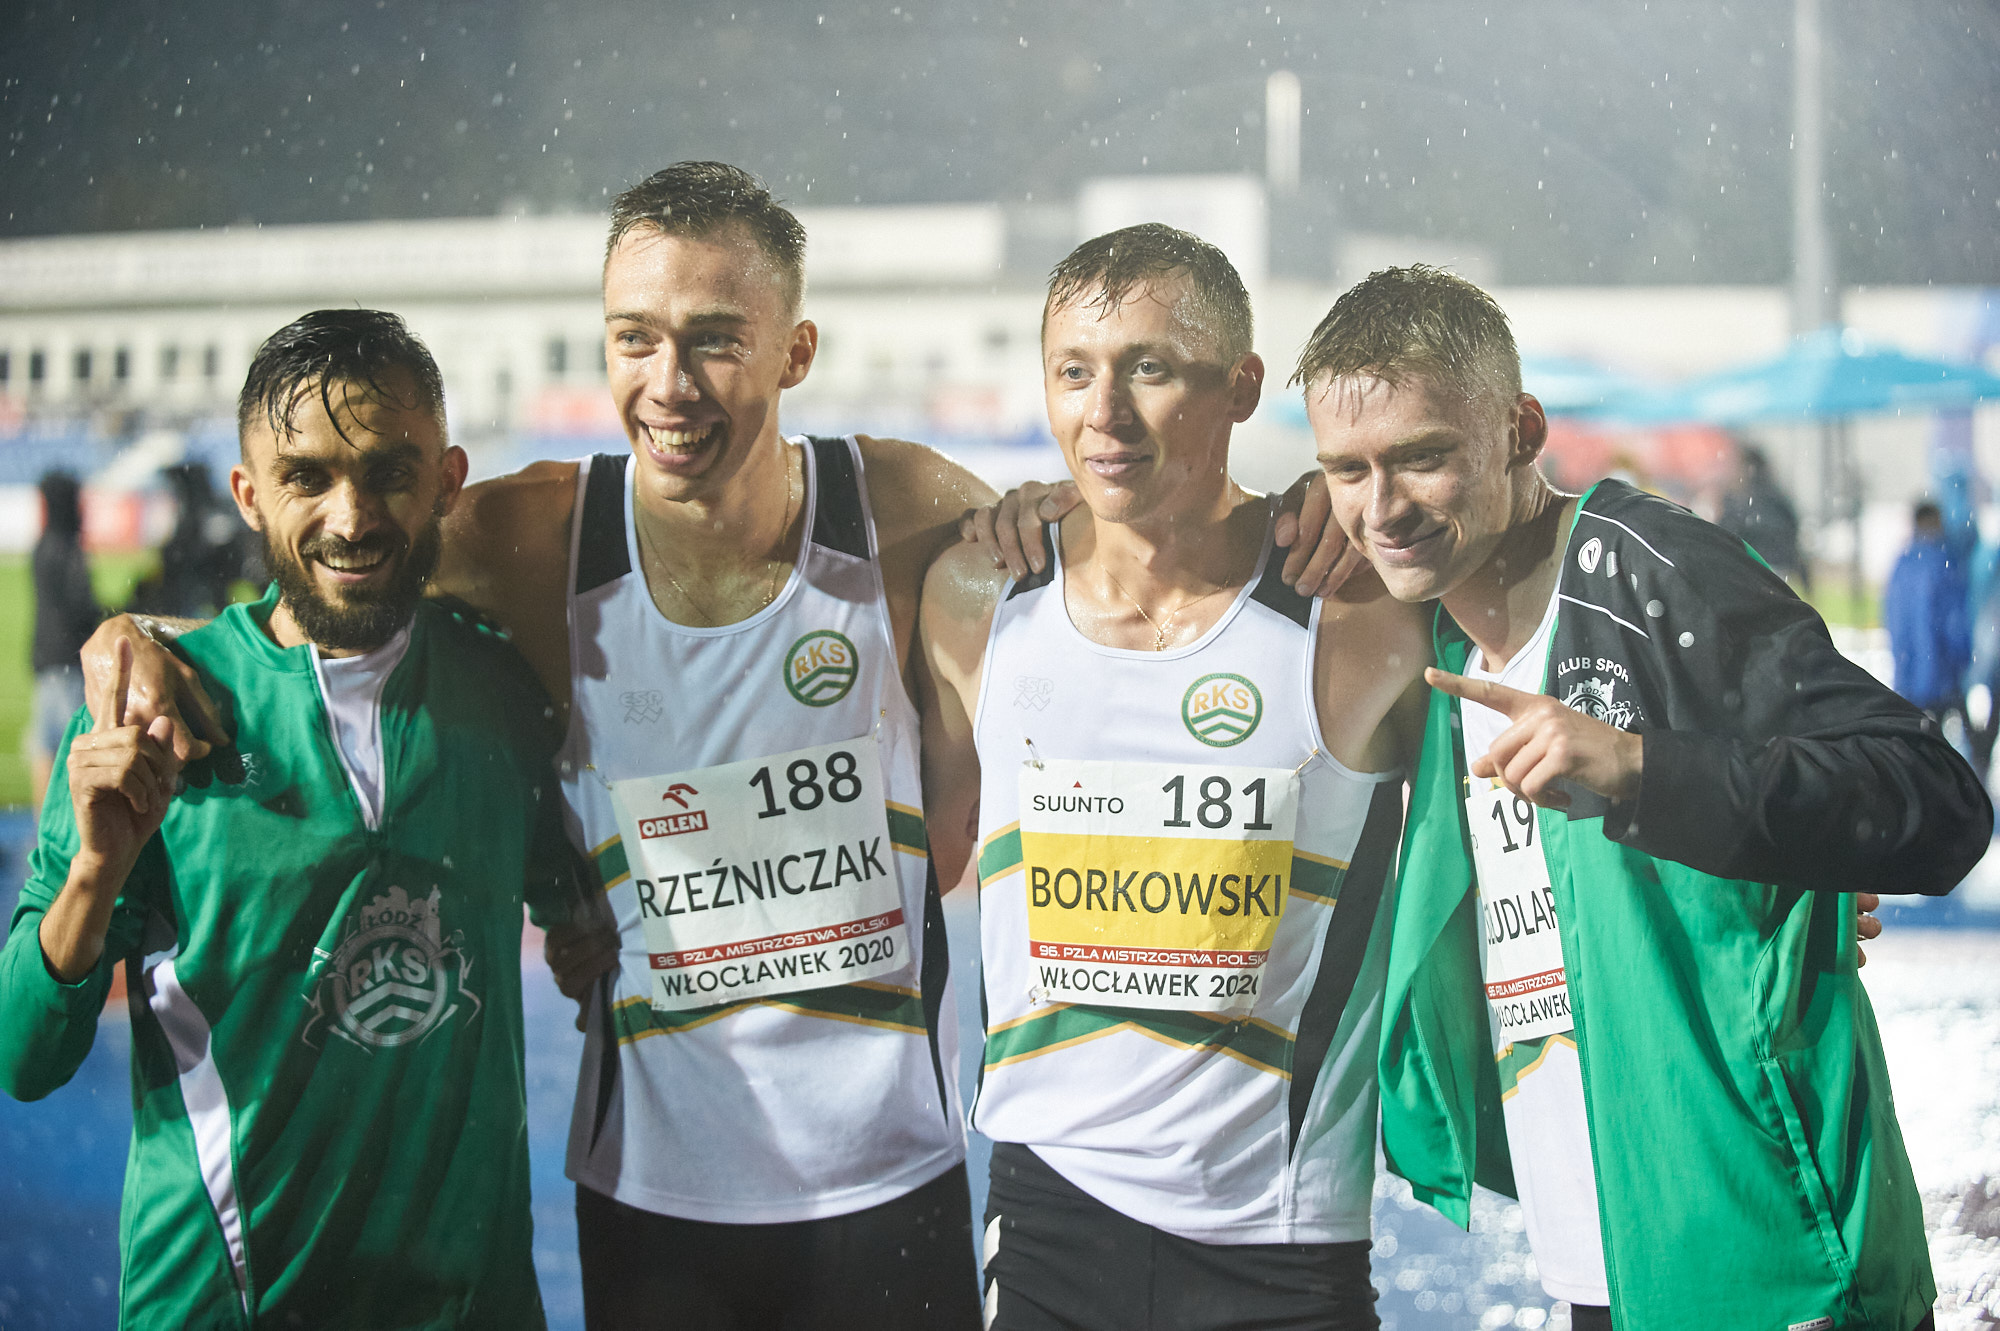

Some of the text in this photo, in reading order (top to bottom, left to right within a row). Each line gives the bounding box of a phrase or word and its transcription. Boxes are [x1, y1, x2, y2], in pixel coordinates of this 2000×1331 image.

[793, 641, 846, 680] RKS
[1194, 683, 1250, 714] RKS
[749, 751, 862, 819] 188
[1033, 795, 1124, 814] SUUNTO
[1162, 775, 1273, 831] 181
[642, 814, 706, 837] ORLEN
[1491, 794, 1534, 854] 19
[636, 836, 888, 919] RZEŹNICZAK
[1031, 866, 1282, 917] BORKOWSKI
[683, 949, 725, 963] PZLA
[726, 930, 838, 956] MISTRZOSTWA
[840, 917, 890, 938] POLSKI
[1484, 886, 1556, 946] UDLAR
[350, 941, 427, 997] RKS
[661, 935, 895, 997] WŁOCŁAWEK 2020
[1039, 945, 1061, 958] 96.
[1063, 947, 1099, 960] PZLA
[1102, 949, 1213, 966] MISTRZOSTWA
[1039, 965, 1200, 998] WŁOCŁAWEK
